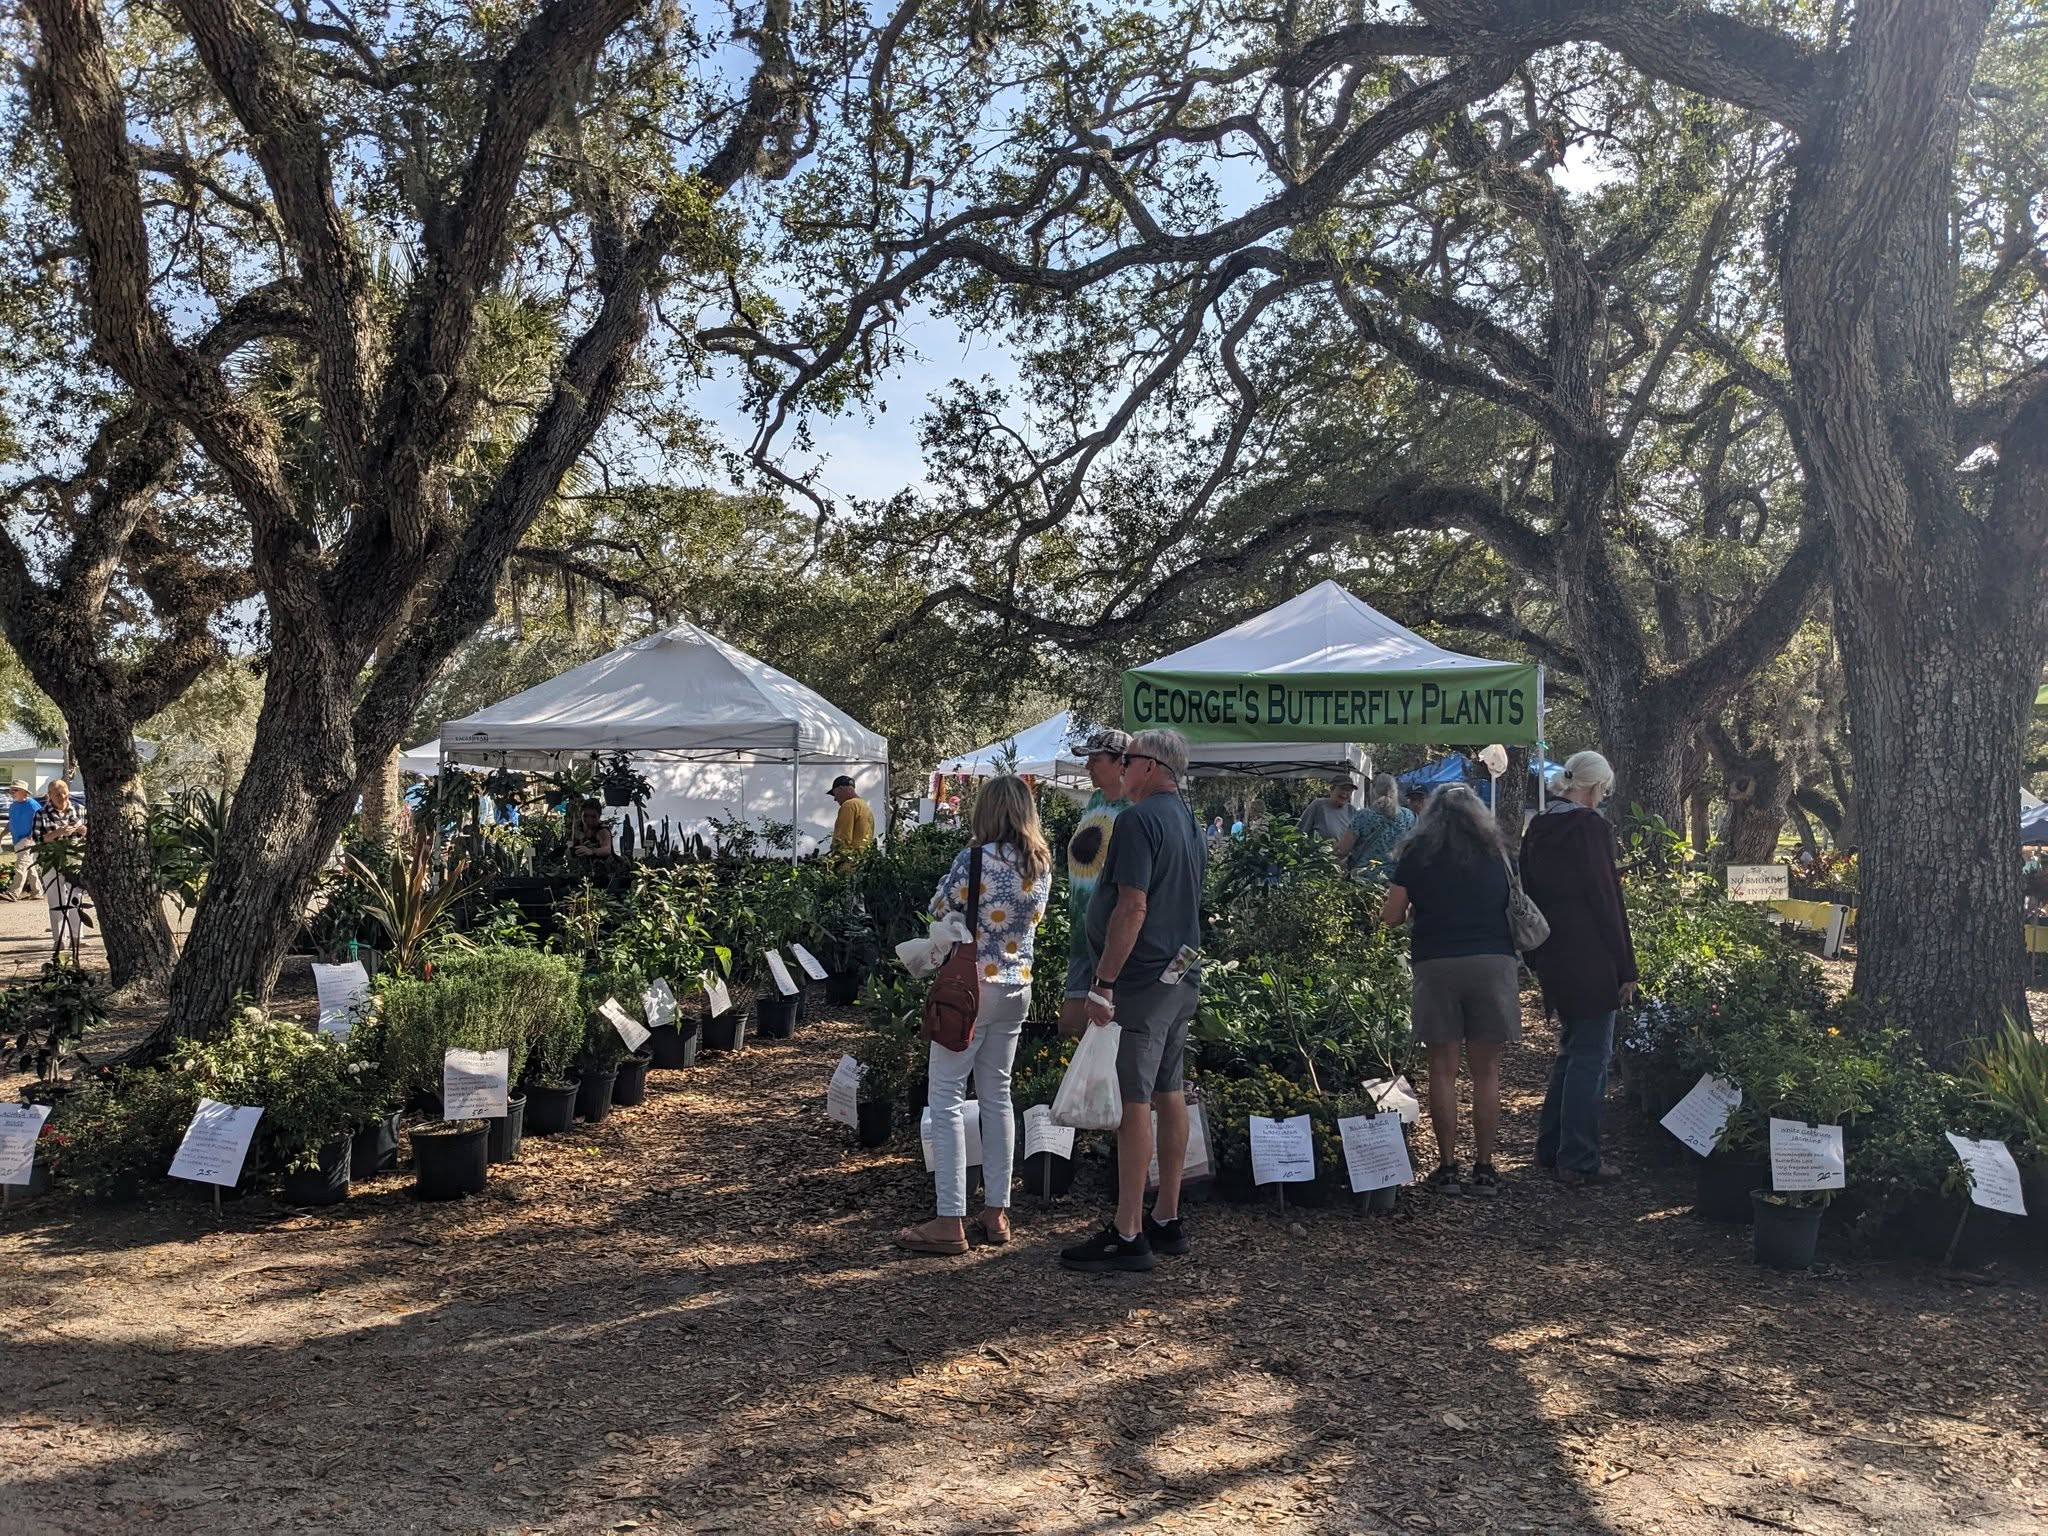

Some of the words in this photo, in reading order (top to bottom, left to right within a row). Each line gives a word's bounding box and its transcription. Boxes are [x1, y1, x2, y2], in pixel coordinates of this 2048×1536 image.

[1133, 681, 1259, 724] GEORGE'S
[1267, 683, 1413, 725] BUTTERFLY
[1421, 682, 1523, 725] PLANTS
[1731, 877, 1744, 885] NO
[1745, 876, 1787, 885] SMOKING
[1748, 887, 1759, 895] IN
[1760, 887, 1783, 895] TENT
